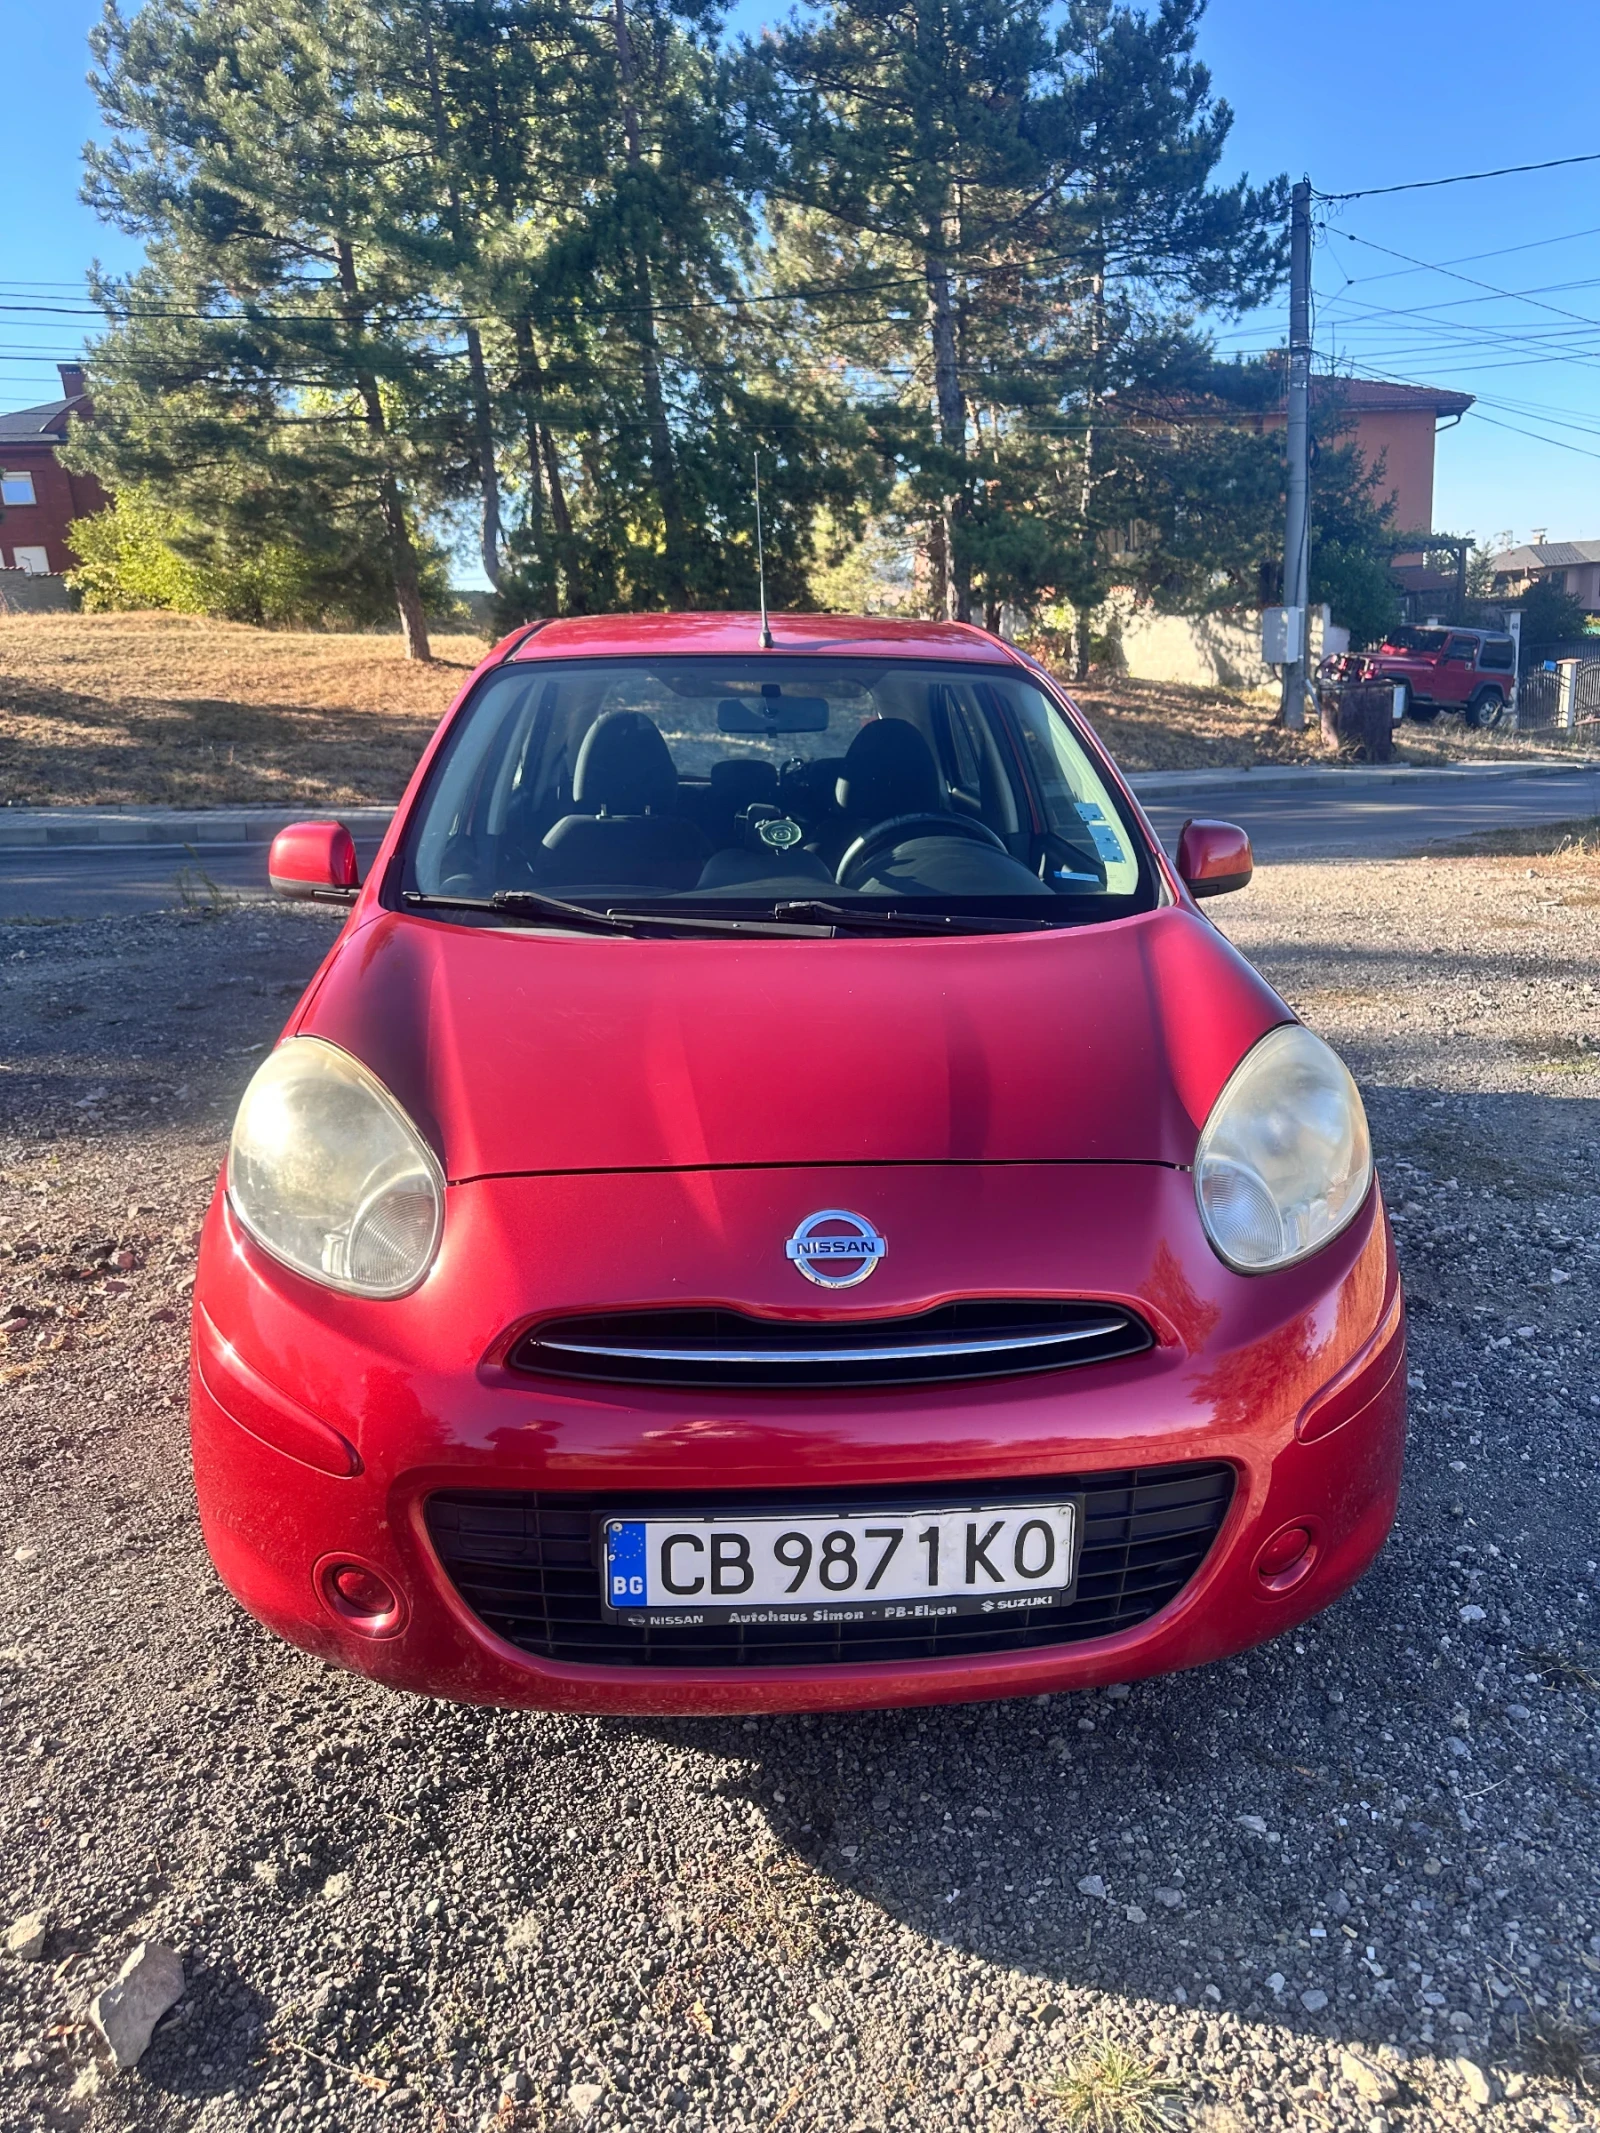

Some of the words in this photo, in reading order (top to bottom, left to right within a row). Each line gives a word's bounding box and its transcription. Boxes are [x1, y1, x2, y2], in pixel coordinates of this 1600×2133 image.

[796, 1241, 875, 1254] NISSAN
[661, 1533, 754, 1595] CB
[773, 1525, 940, 1592] 9871
[965, 1519, 1055, 1584] KO
[613, 1576, 643, 1595] BG
[997, 1596, 1053, 1610] SUZUKI
[650, 1615, 704, 1625] NISSAN
[728, 1610, 808, 1623] Autohaus
[812, 1604, 864, 1621] Simon
[884, 1605, 957, 1618] PB-Elsen
